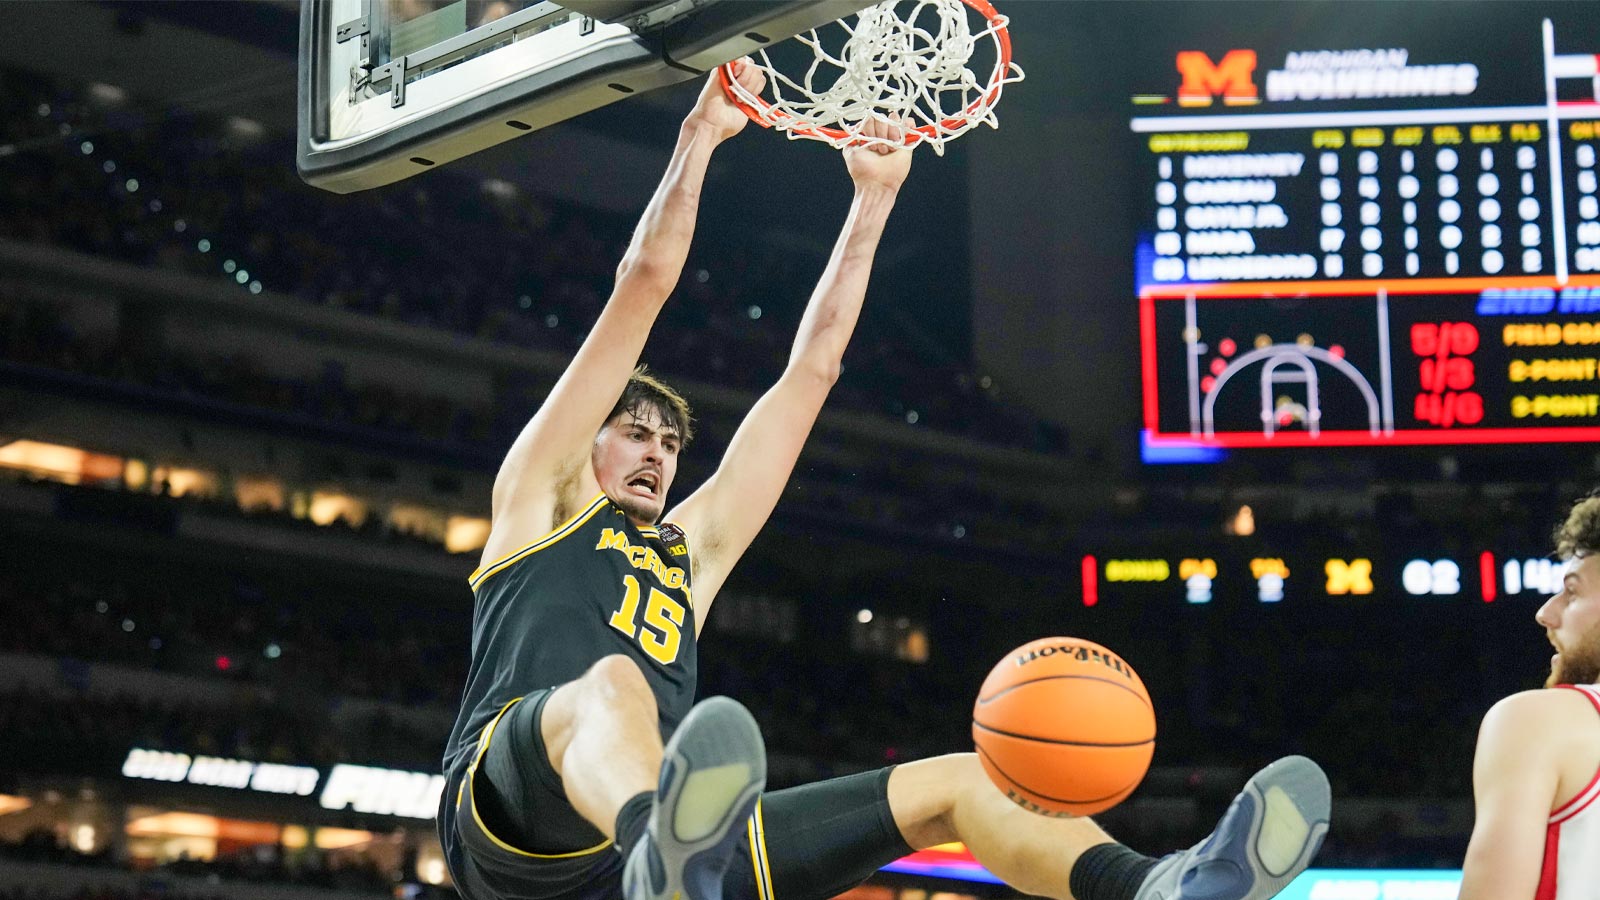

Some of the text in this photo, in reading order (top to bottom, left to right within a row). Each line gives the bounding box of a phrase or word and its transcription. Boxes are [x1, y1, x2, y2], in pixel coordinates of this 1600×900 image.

[1284, 46, 1409, 70] MICHIGAN
[1176, 49, 1260, 107] M
[1266, 63, 1480, 101] WOLVERINES
[1325, 558, 1373, 595] M
[1402, 558, 1461, 595] 62
[608, 574, 686, 666] 15
[1016, 645, 1133, 680] Wilson
